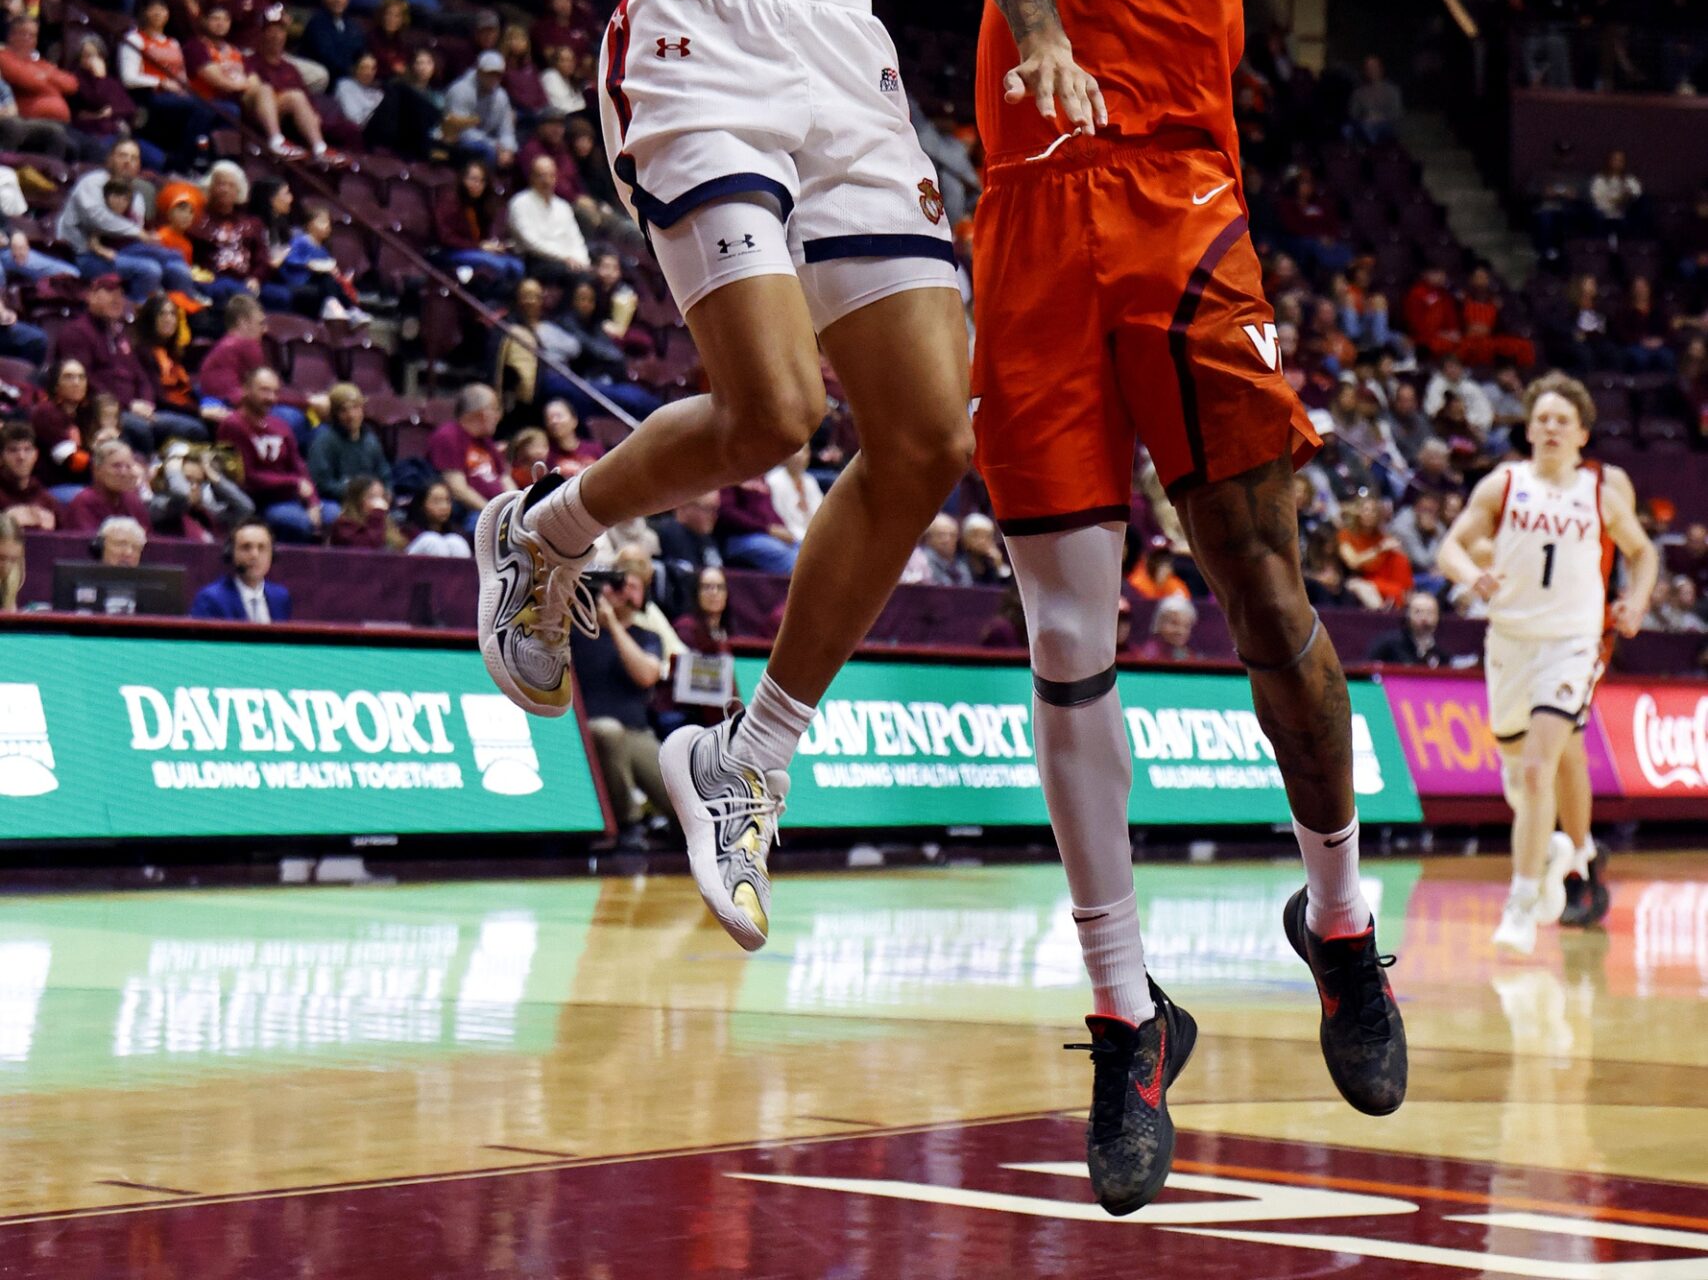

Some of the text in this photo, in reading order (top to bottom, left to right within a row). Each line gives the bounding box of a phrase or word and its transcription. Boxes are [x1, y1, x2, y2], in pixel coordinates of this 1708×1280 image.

[1511, 509, 1591, 542] NAVY
[1542, 543, 1555, 588] 1
[119, 685, 455, 754] DAVENPORT
[152, 761, 464, 789] BUILDING WEALTH TOGETHER
